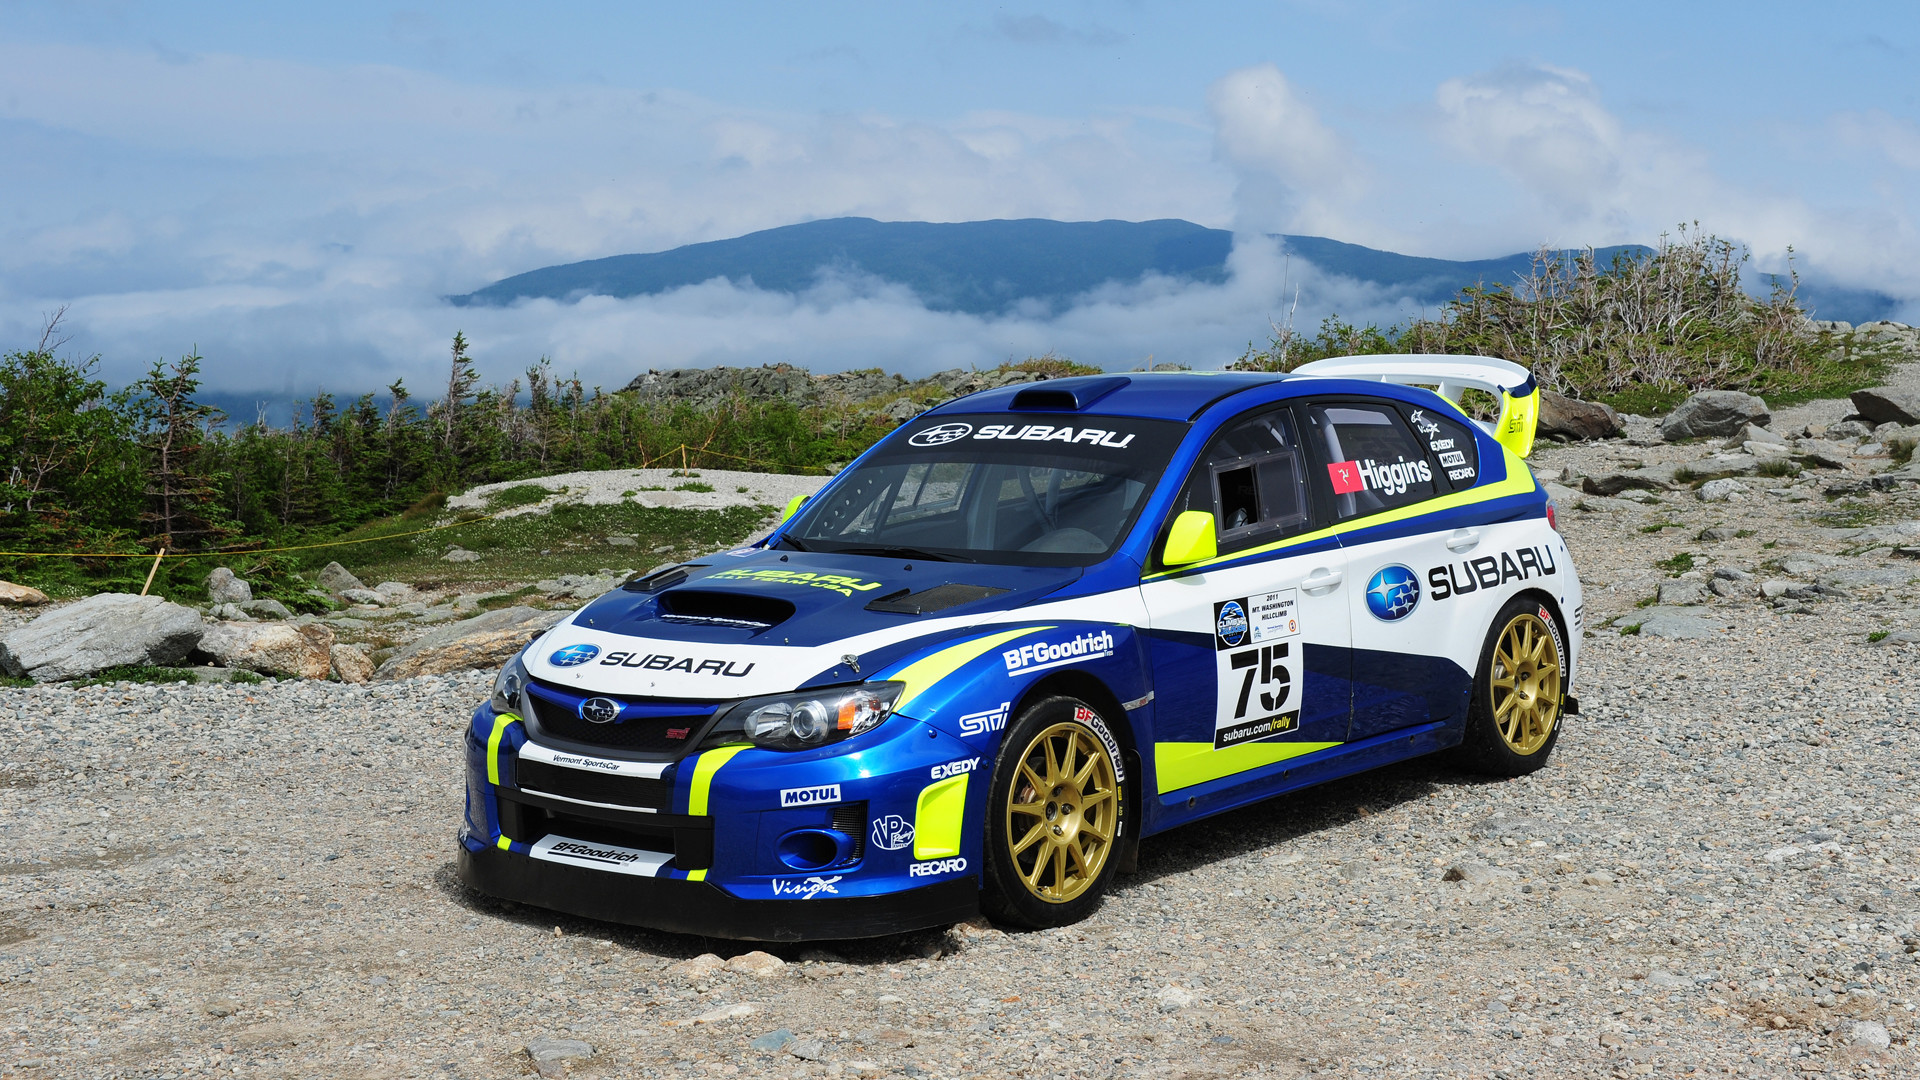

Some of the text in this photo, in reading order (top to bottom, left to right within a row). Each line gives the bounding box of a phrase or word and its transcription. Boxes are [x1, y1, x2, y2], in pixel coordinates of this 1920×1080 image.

[1430, 438, 1455, 451] EXEDY
[1441, 453, 1464, 465] MOTUL
[1355, 455, 1433, 495] Higgins
[1448, 467, 1475, 481] RECARO
[1428, 544, 1556, 601] SUBARU
[810, 582, 853, 597] USA
[1261, 600, 1294, 611] WASHINGTON
[1262, 610, 1288, 620] HILLCLIMB
[1002, 630, 1114, 670] BFGoodrich
[600, 651, 756, 677] SUBARU
[1230, 642, 1291, 719] 75
[1222, 716, 1292, 742] subaru.com/rally
[553, 755, 582, 765] Vermont
[931, 757, 981, 779] EXEDY
[785, 788, 838, 804] MOTUL
[551, 842, 639, 862] BFGoodrich
[909, 858, 968, 877] RECARO
